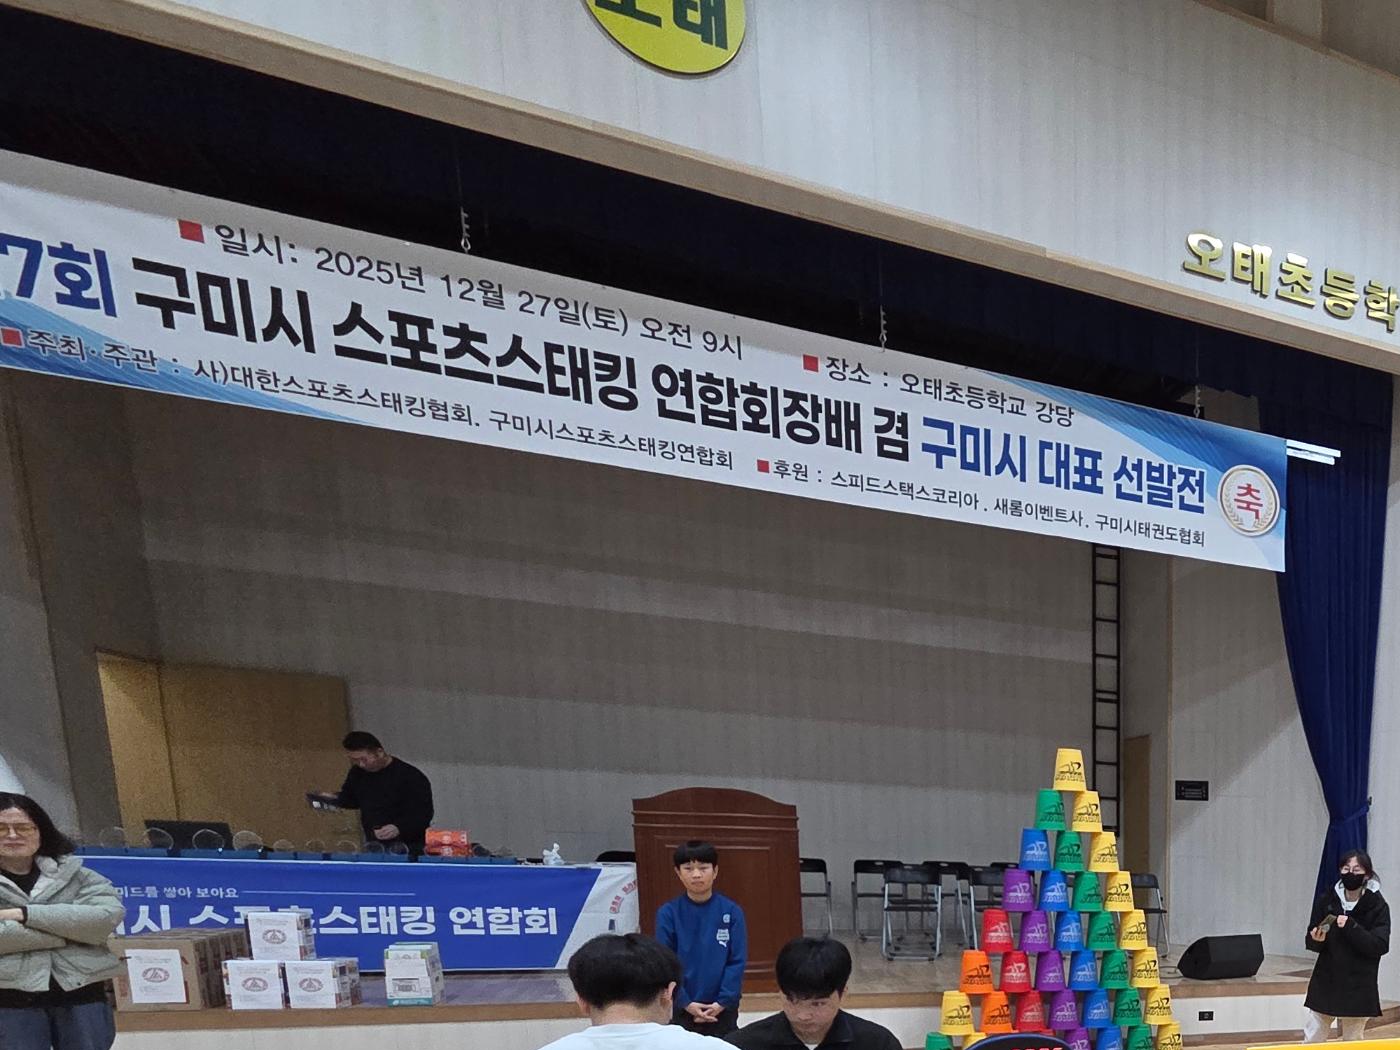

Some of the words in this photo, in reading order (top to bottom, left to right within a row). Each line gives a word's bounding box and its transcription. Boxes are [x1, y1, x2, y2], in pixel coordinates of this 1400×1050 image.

[215, 224, 297, 264] 일시:
[315, 247, 425, 294] 2025년
[440, 274, 506, 310] 12월
[518, 291, 628, 336] 27일(토)
[640, 317, 693, 350] 오전
[702, 330, 742, 360] 9시
[132, 256, 316, 354] 구미시
[333, 301, 639, 412] 스포츠스태킹
[651, 363, 863, 454] 연합회장배
[874, 406, 909, 462] 겸
[921, 416, 1027, 483] 구미시
[1039, 439, 1104, 495] 대표
[1113, 454, 1205, 514] 선발전
[826, 355, 872, 385] 장소
[899, 372, 1027, 417] 오태초등학교
[1036, 400, 1074, 428] 강당
[488, 409, 733, 470] 구미시스포츠스태킹연합회
[773, 458, 809, 483] 후원
[830, 470, 979, 511] 스피드스택스코리아
[1095, 514, 1205, 547] 구미시태권도협회
[1233, 482, 1264, 520] 축
[115, 886, 158, 899] 미드를
[196, 887, 239, 899] 보아요
[449, 906, 557, 936] 연합회
